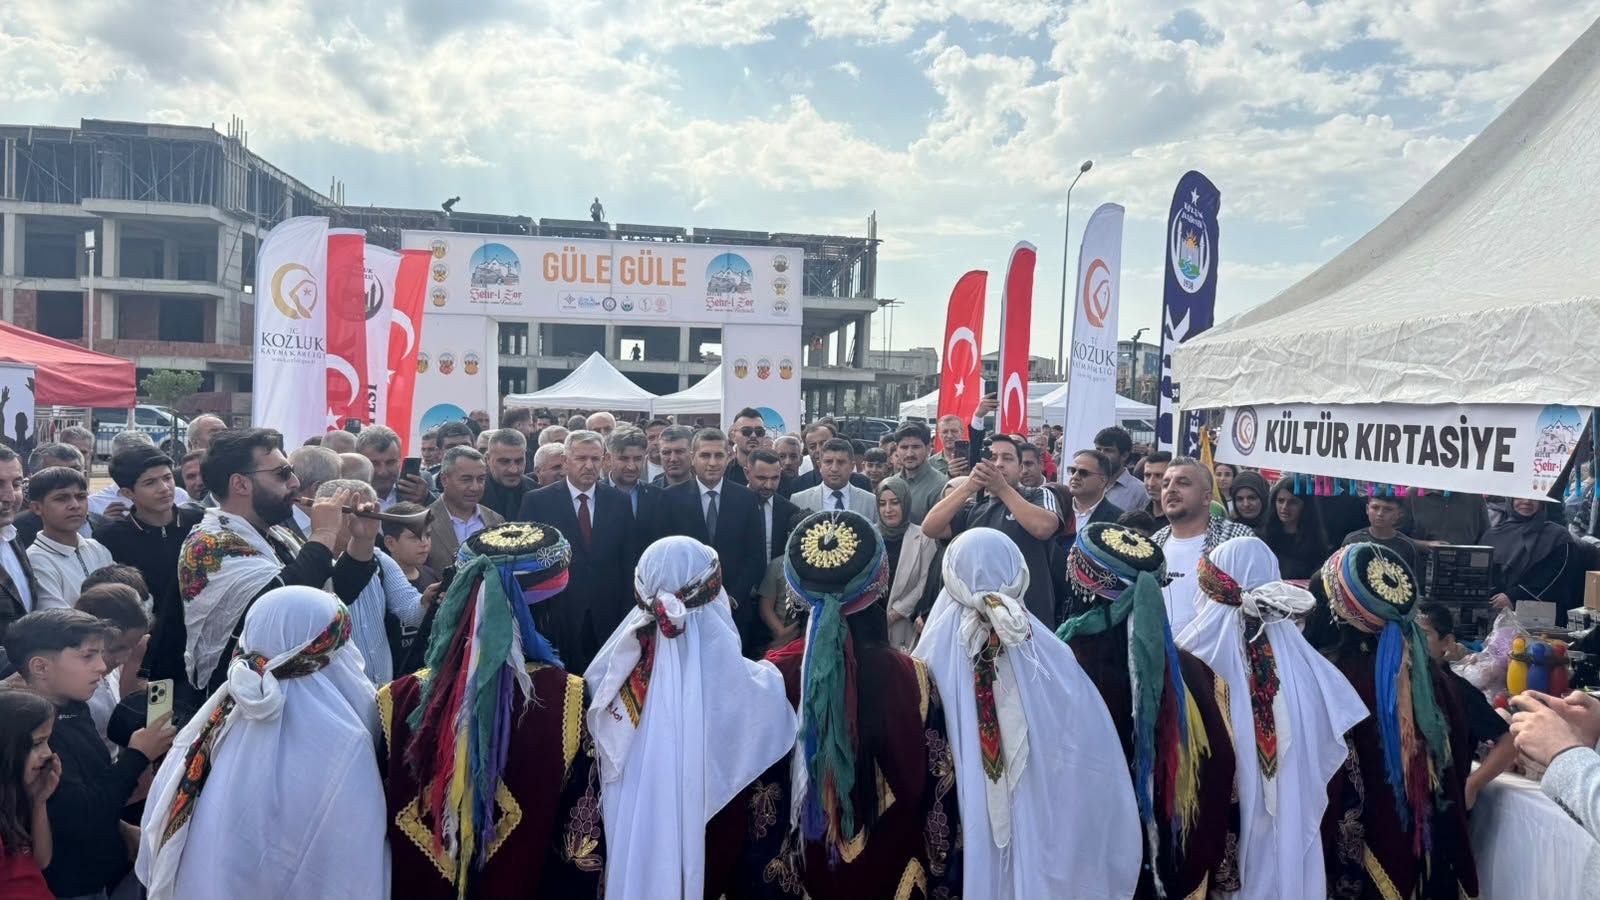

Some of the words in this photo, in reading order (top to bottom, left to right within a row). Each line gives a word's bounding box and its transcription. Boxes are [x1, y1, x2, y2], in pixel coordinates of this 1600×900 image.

[543, 245, 611, 284] GÜLE
[620, 249, 687, 287] GÜLE
[261, 331, 325, 352] KOZLUK
[1265, 410, 1349, 459] KÜLTÜR
[1354, 414, 1517, 473] KIRTASİYE
